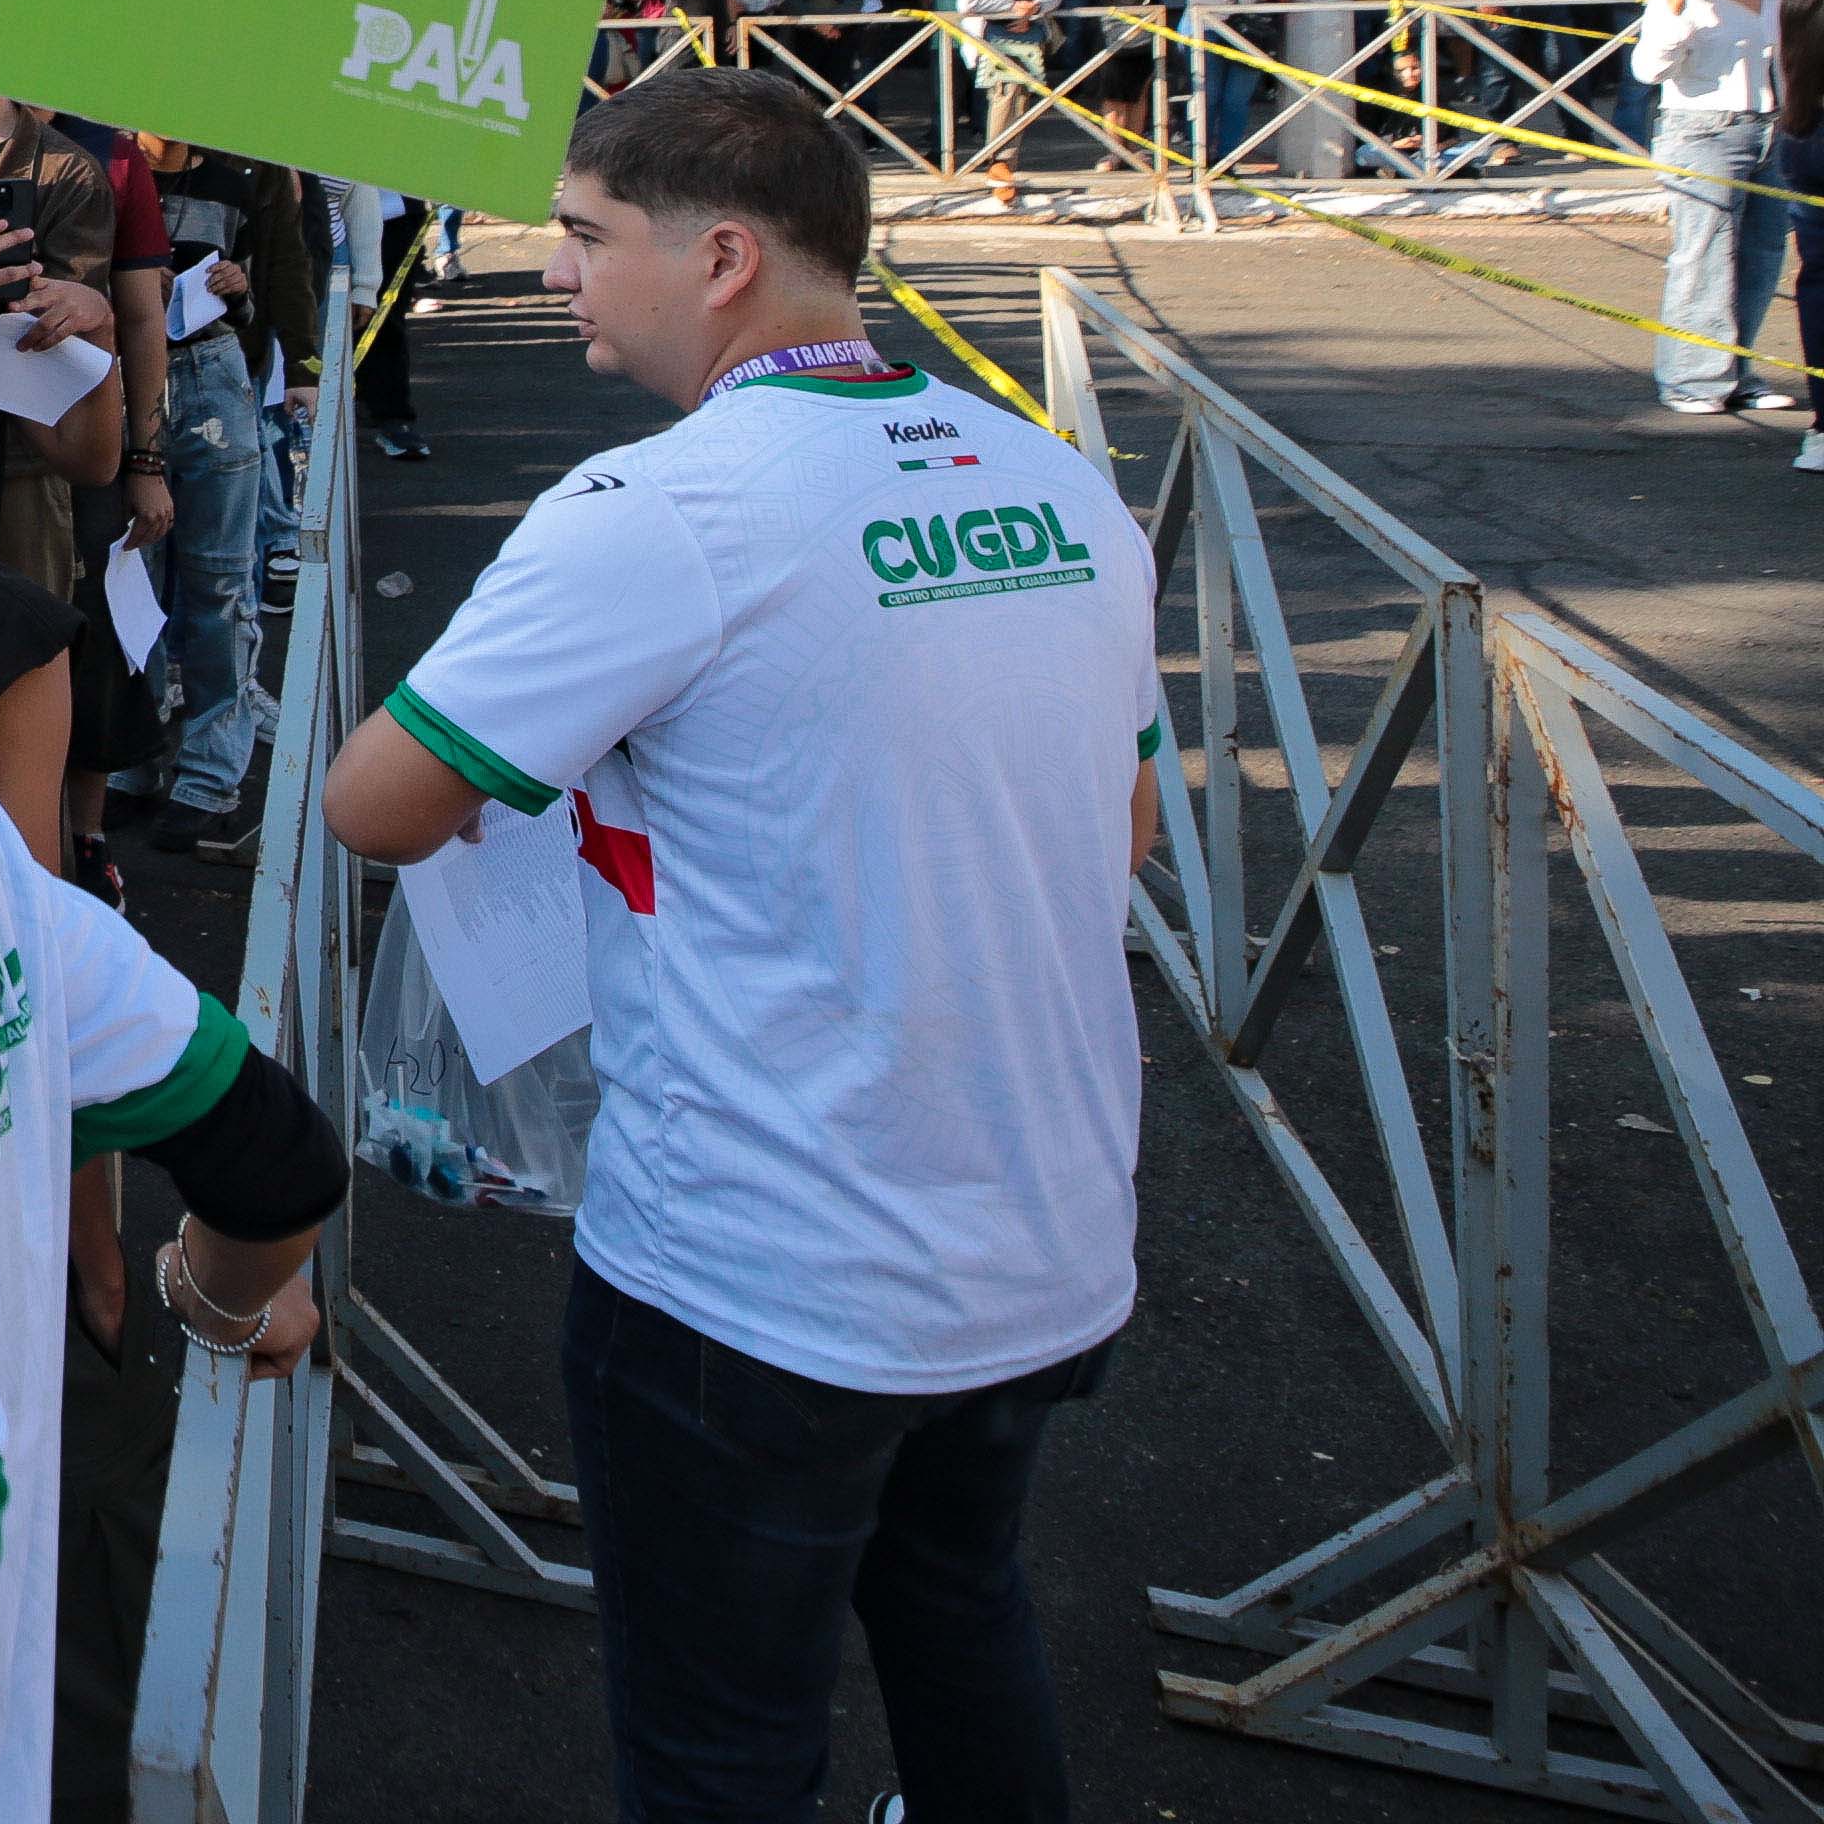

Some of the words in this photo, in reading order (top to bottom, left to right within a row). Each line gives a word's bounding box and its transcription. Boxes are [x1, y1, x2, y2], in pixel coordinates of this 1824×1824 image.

[710, 353, 787, 398] INSPIRA.
[882, 416, 961, 445] Keuka
[862, 502, 1091, 584] CUGDL
[887, 591, 930, 605] CENTRO
[930, 580, 1003, 600] UNIVERSITARIO
[1003, 578, 1019, 590] DE
[1020, 569, 1090, 589] GUADALAJARA
